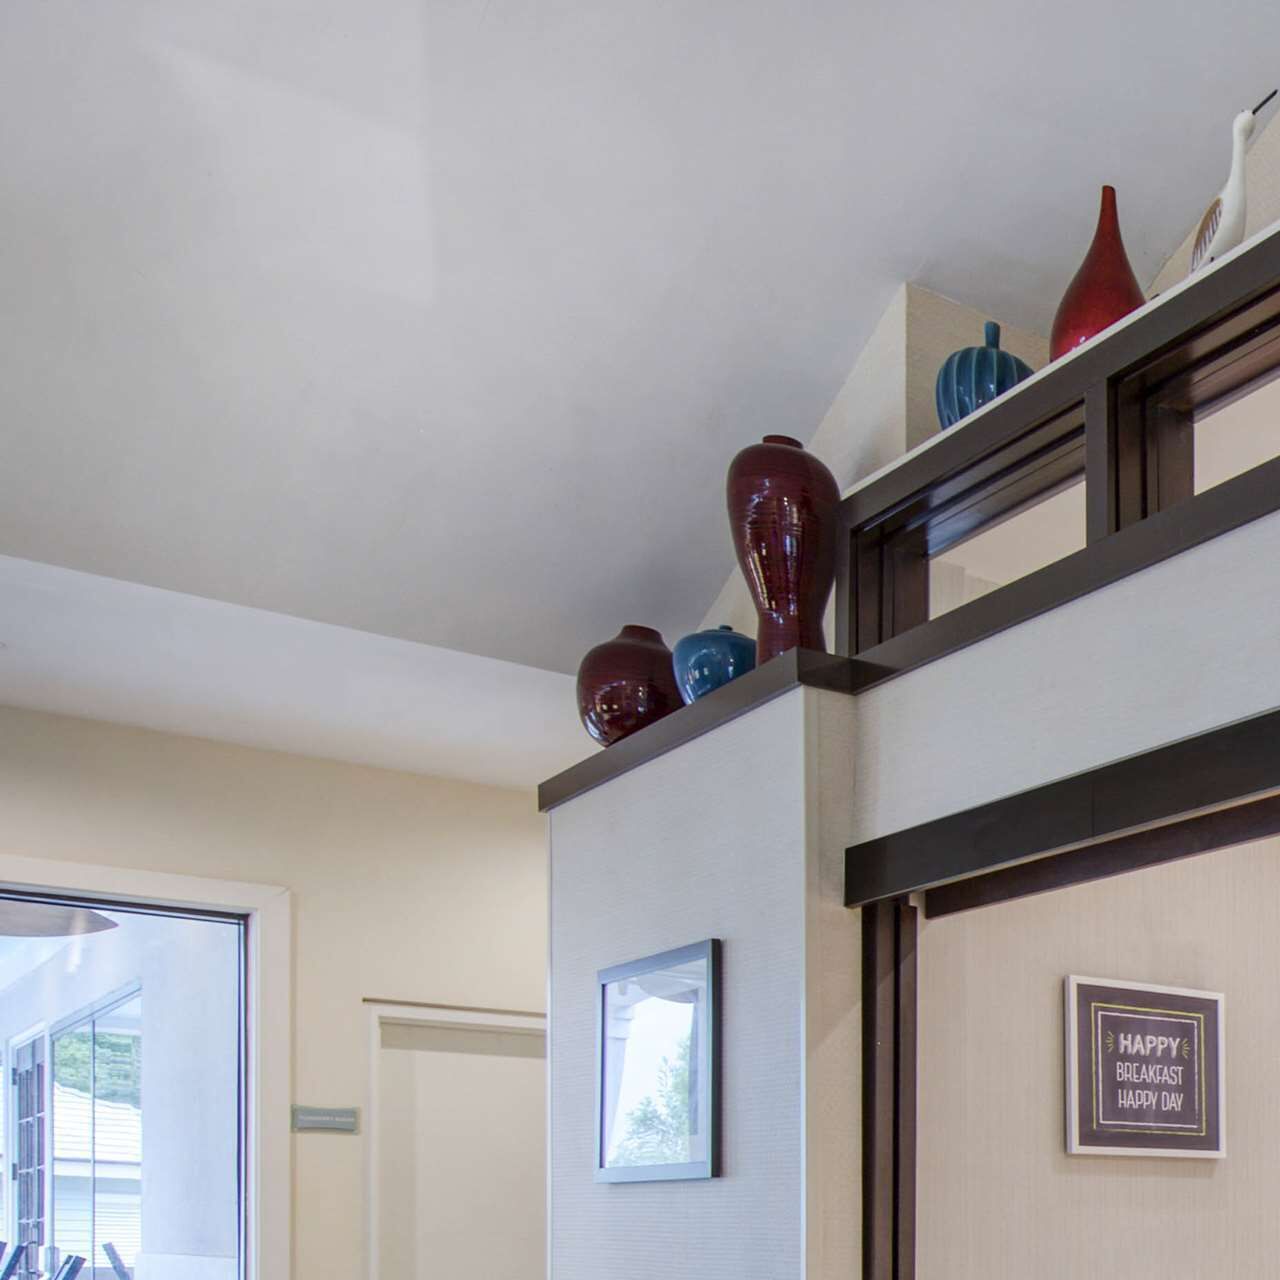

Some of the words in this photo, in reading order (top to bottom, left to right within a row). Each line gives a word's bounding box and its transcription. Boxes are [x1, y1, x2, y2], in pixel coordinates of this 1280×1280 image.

[1119, 1033, 1181, 1058] HAPPY
[1116, 1061, 1184, 1086] BREAKFAST
[1118, 1089, 1159, 1111] HAPPY
[1161, 1092, 1184, 1111] DAY
